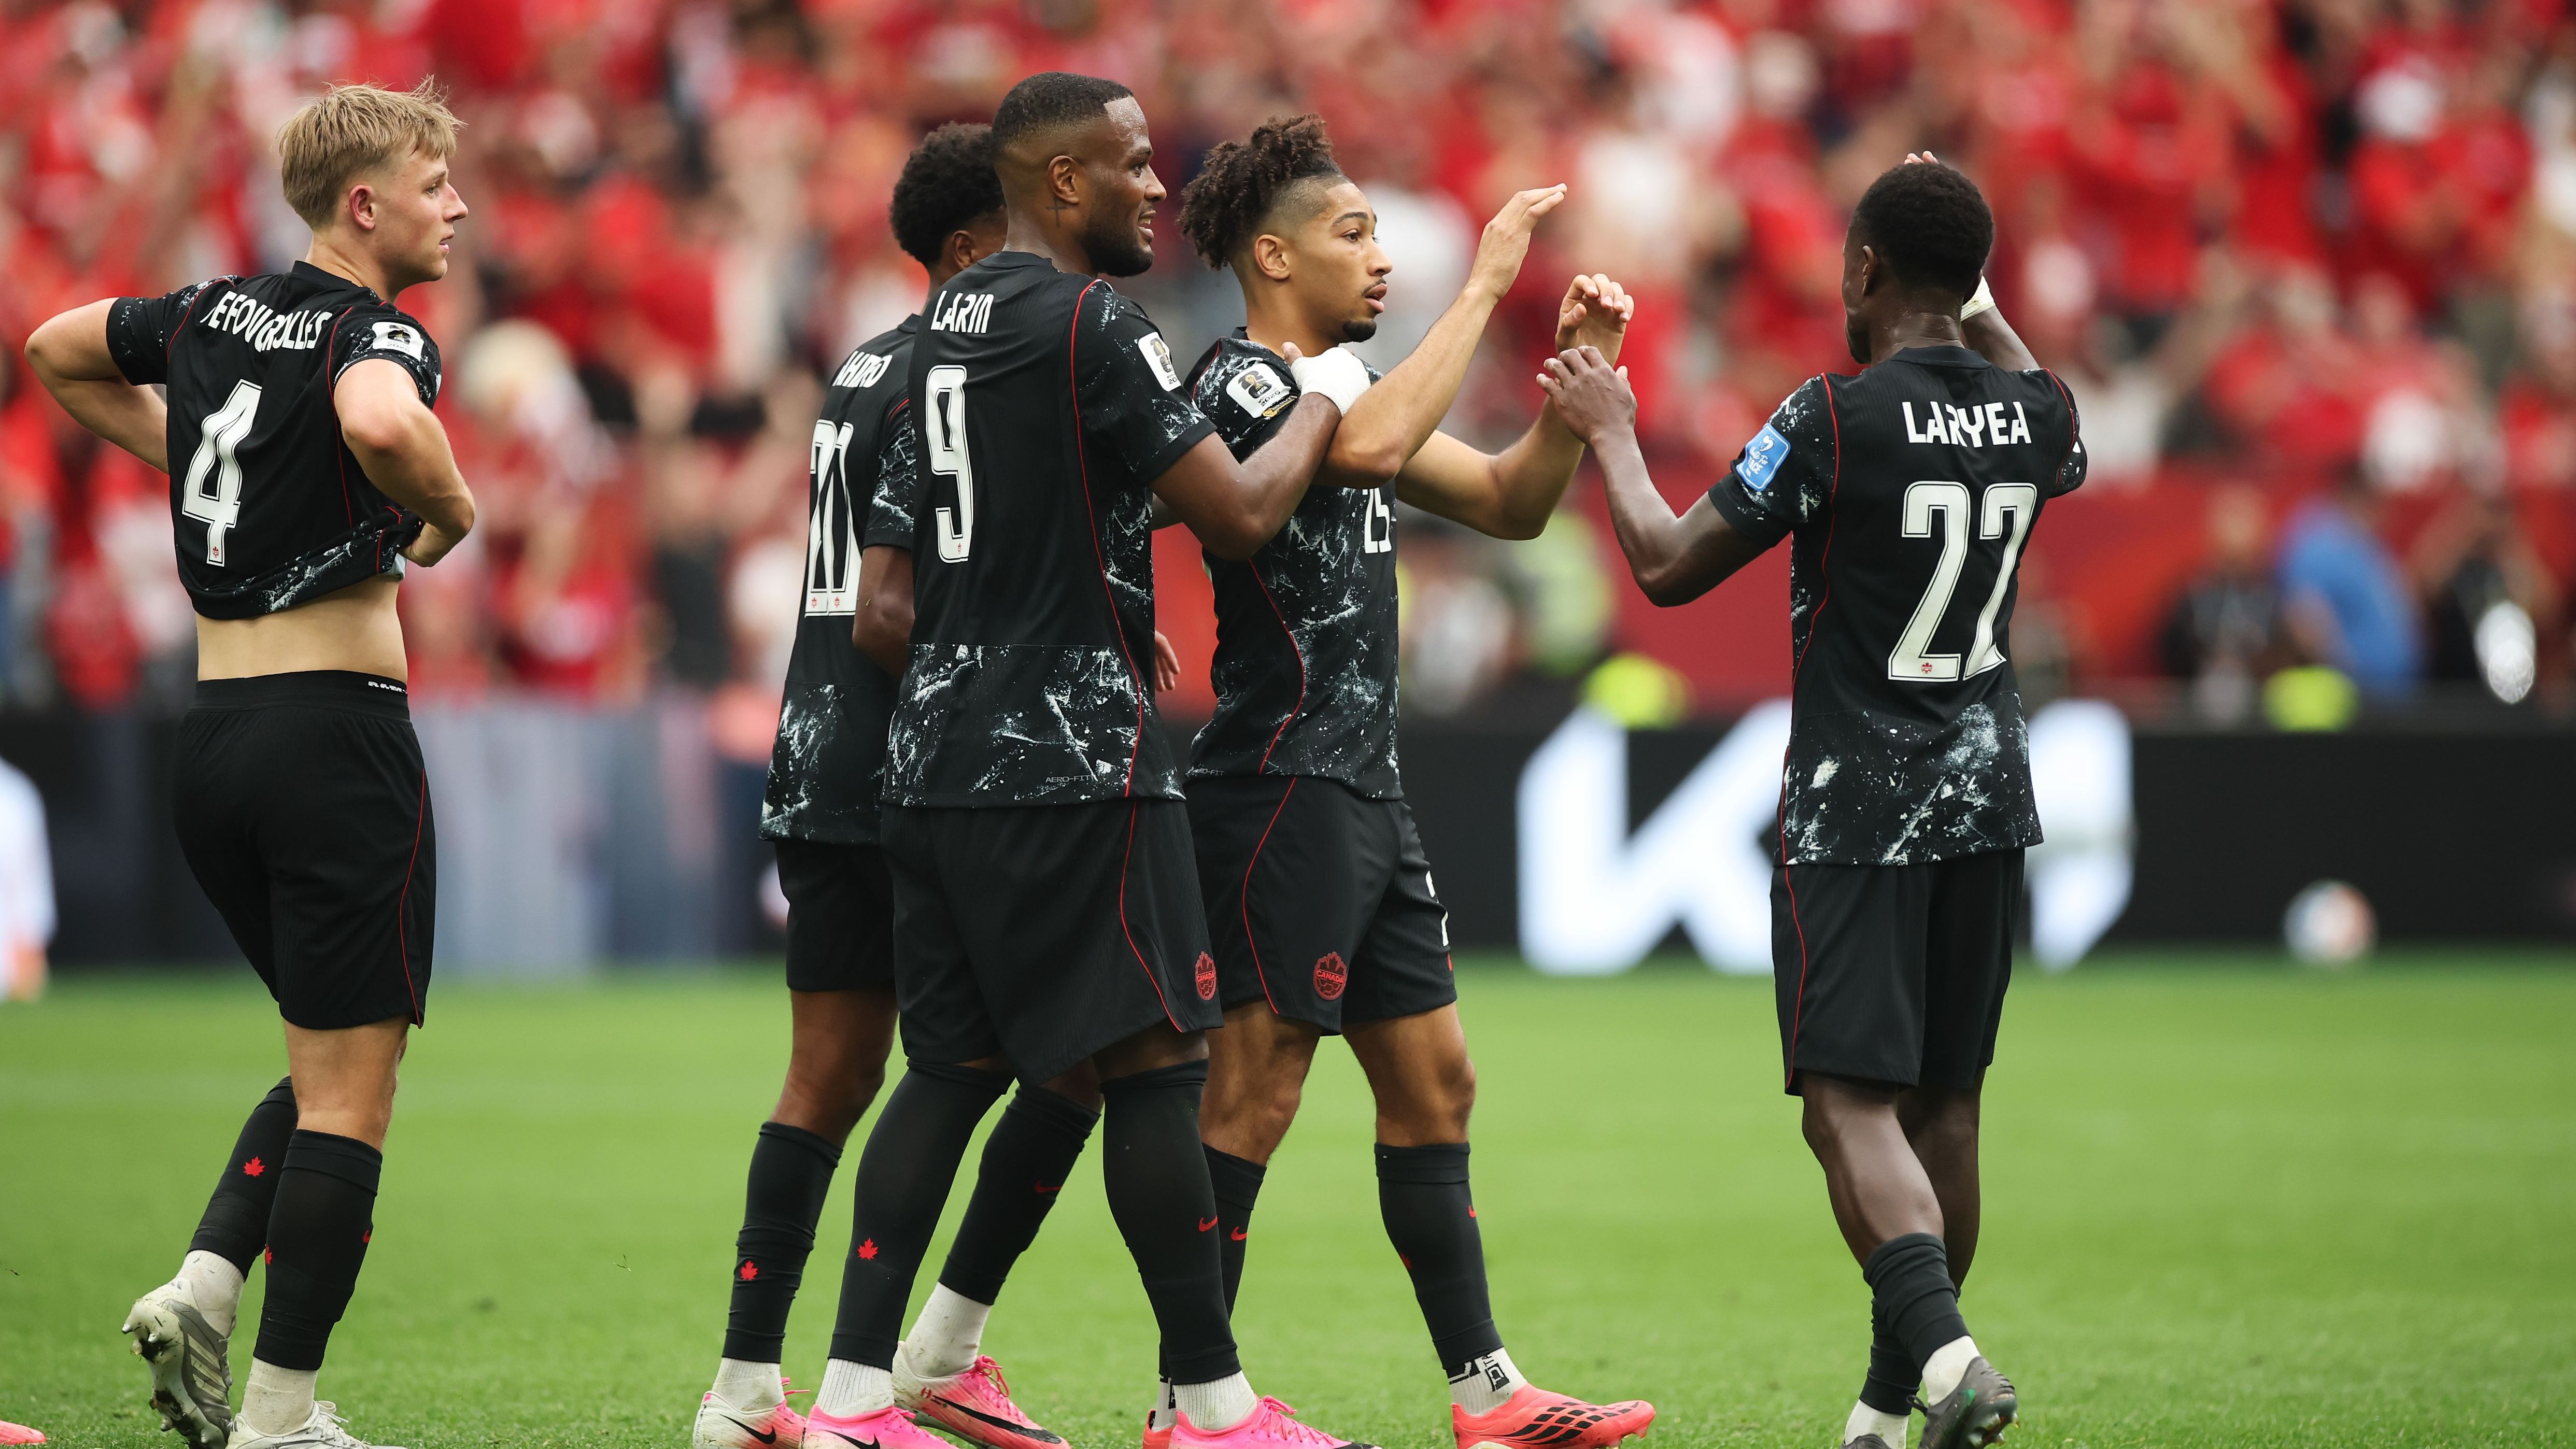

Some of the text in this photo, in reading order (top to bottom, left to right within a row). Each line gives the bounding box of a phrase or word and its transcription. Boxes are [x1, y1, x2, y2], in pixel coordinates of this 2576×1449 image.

[931, 291, 994, 333] LARIN
[1261, 390, 1280, 407] 2026
[1902, 401, 2032, 448] LARYEA
[182, 379, 262, 567] 4
[926, 365, 973, 563] 9
[1888, 481, 2039, 681] 22
[1045, 775, 1091, 783] AERO-FIT
[1197, 972, 1215, 983] CANADA
[1317, 970, 1344, 984] CANADA
